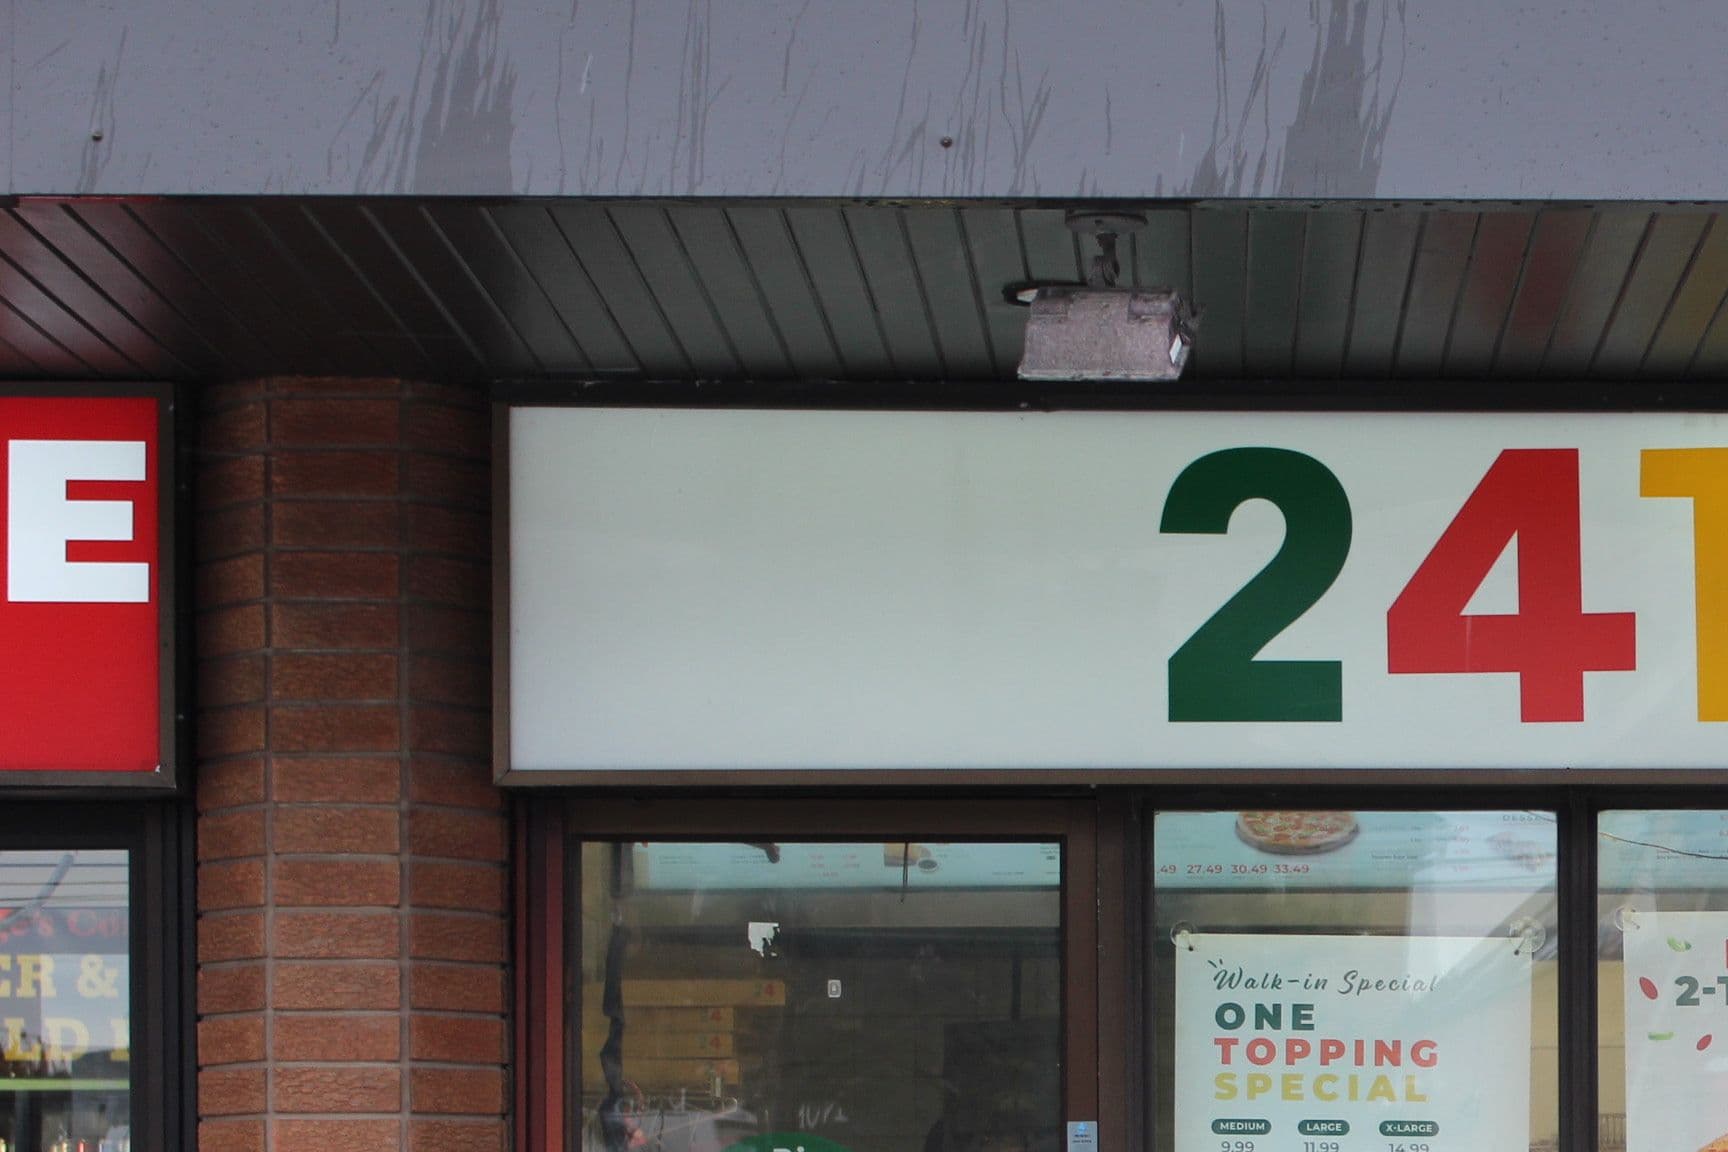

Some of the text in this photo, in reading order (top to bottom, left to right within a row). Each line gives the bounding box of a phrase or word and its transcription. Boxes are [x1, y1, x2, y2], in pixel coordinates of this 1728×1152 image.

[8, 440, 149, 602] E
[77, 954, 119, 998] &
[1212, 964, 1440, 996] Walk-in Special
[1215, 1002, 1315, 1031] ONE
[1214, 1037, 1438, 1068] TOPPING
[1214, 1072, 1429, 1102] SPECIAL
[1219, 1121, 1266, 1132] MEDIUM
[1306, 1122, 1342, 1132] LARGE
[1385, 1123, 1433, 1134] X-LARGE
